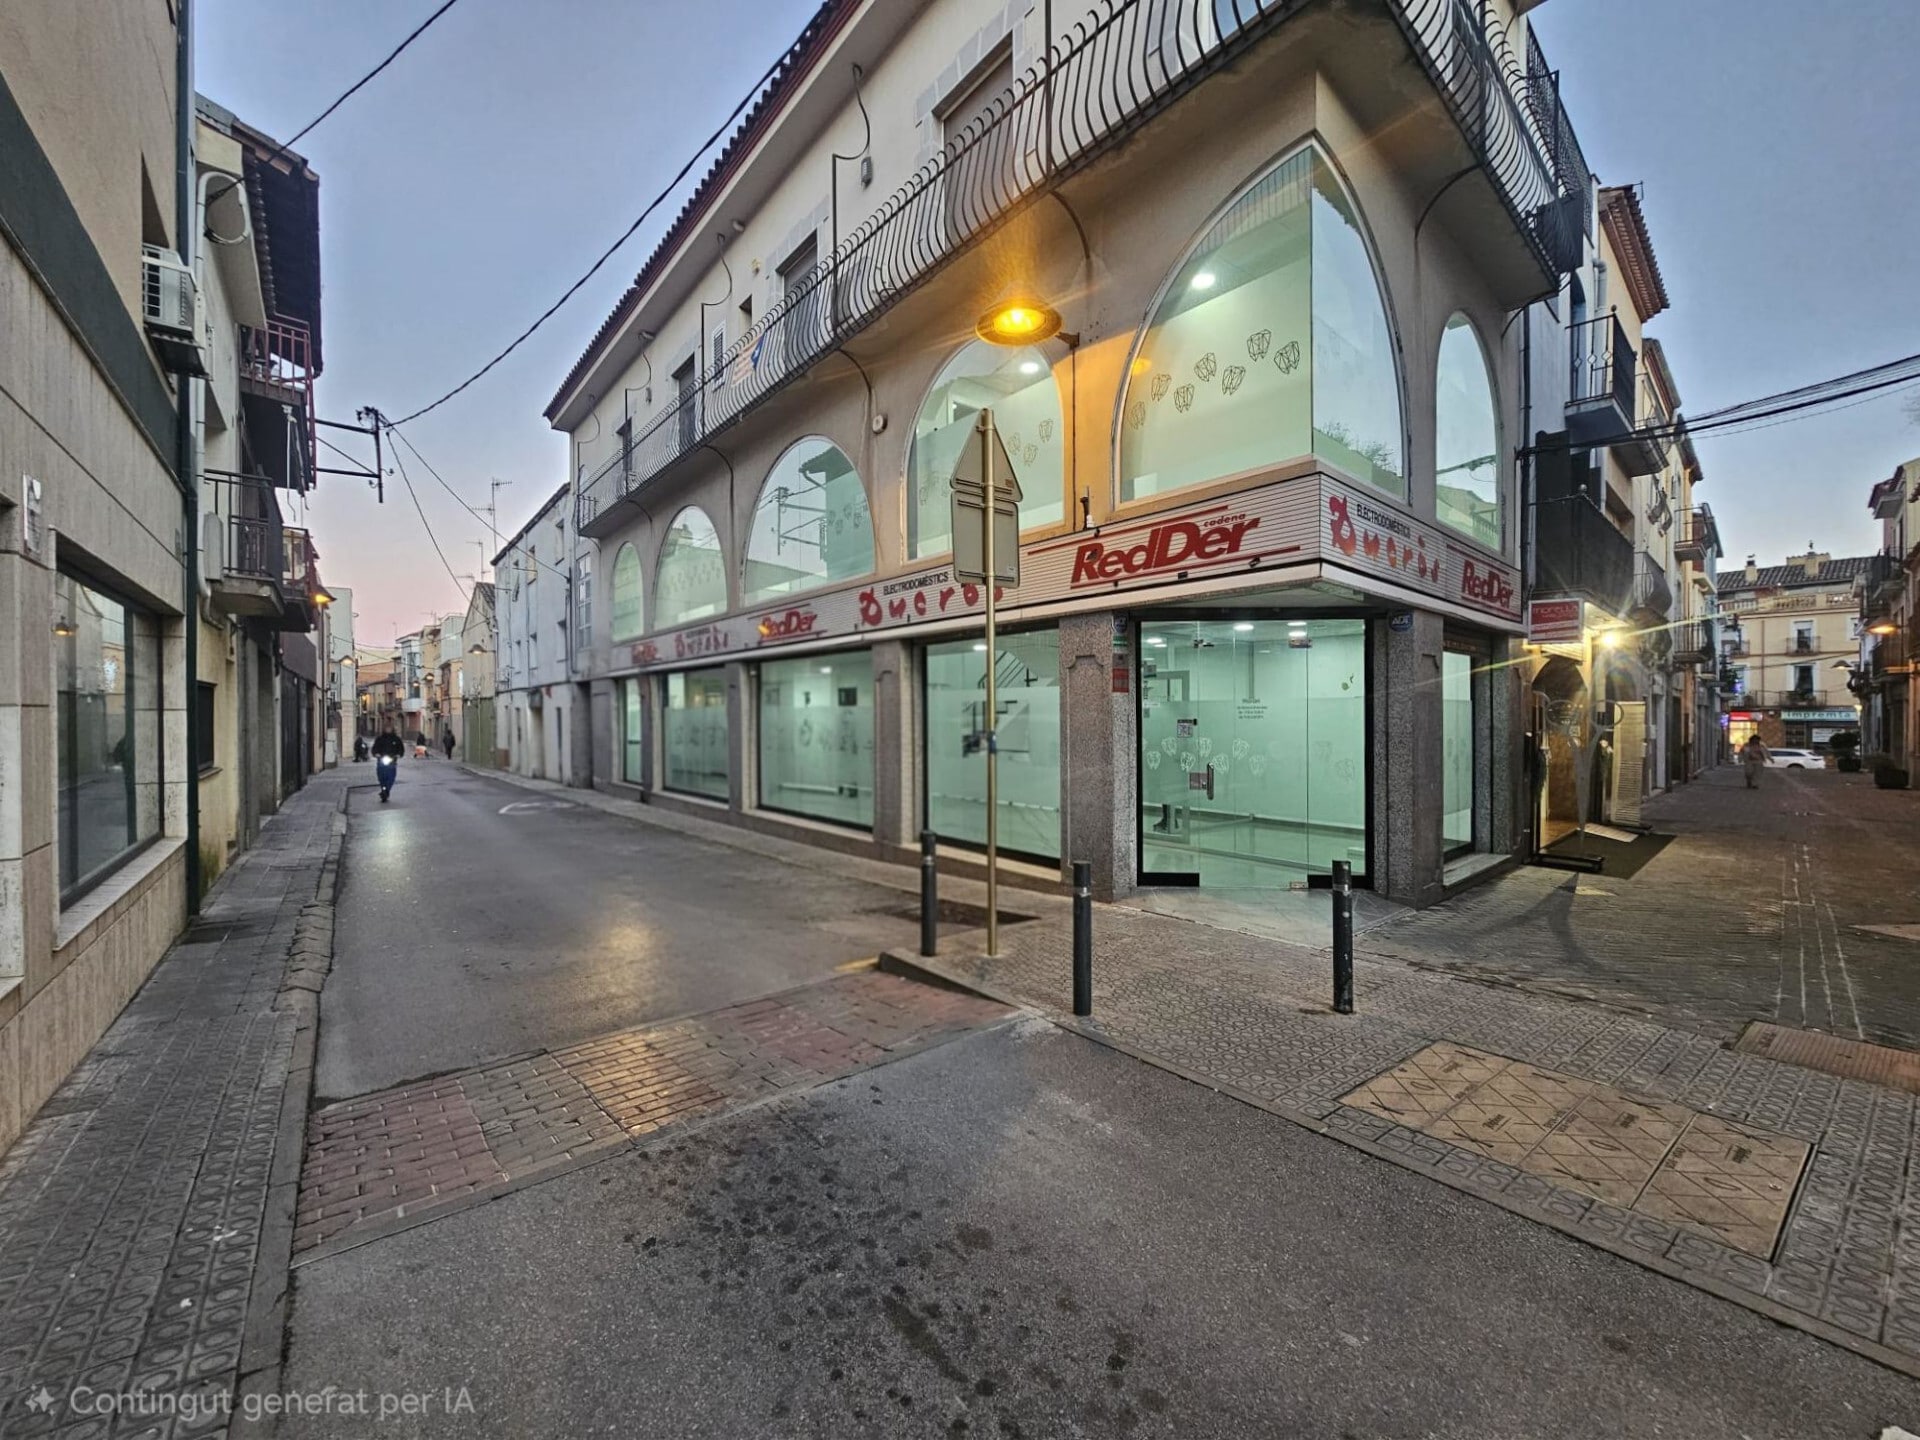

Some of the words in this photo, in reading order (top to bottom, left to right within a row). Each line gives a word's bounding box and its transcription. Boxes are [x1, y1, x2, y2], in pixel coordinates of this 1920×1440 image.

[1203, 513, 1246, 528] cadena
[1070, 517, 1261, 584] RedDer
[1461, 559, 1514, 609] RedDer
